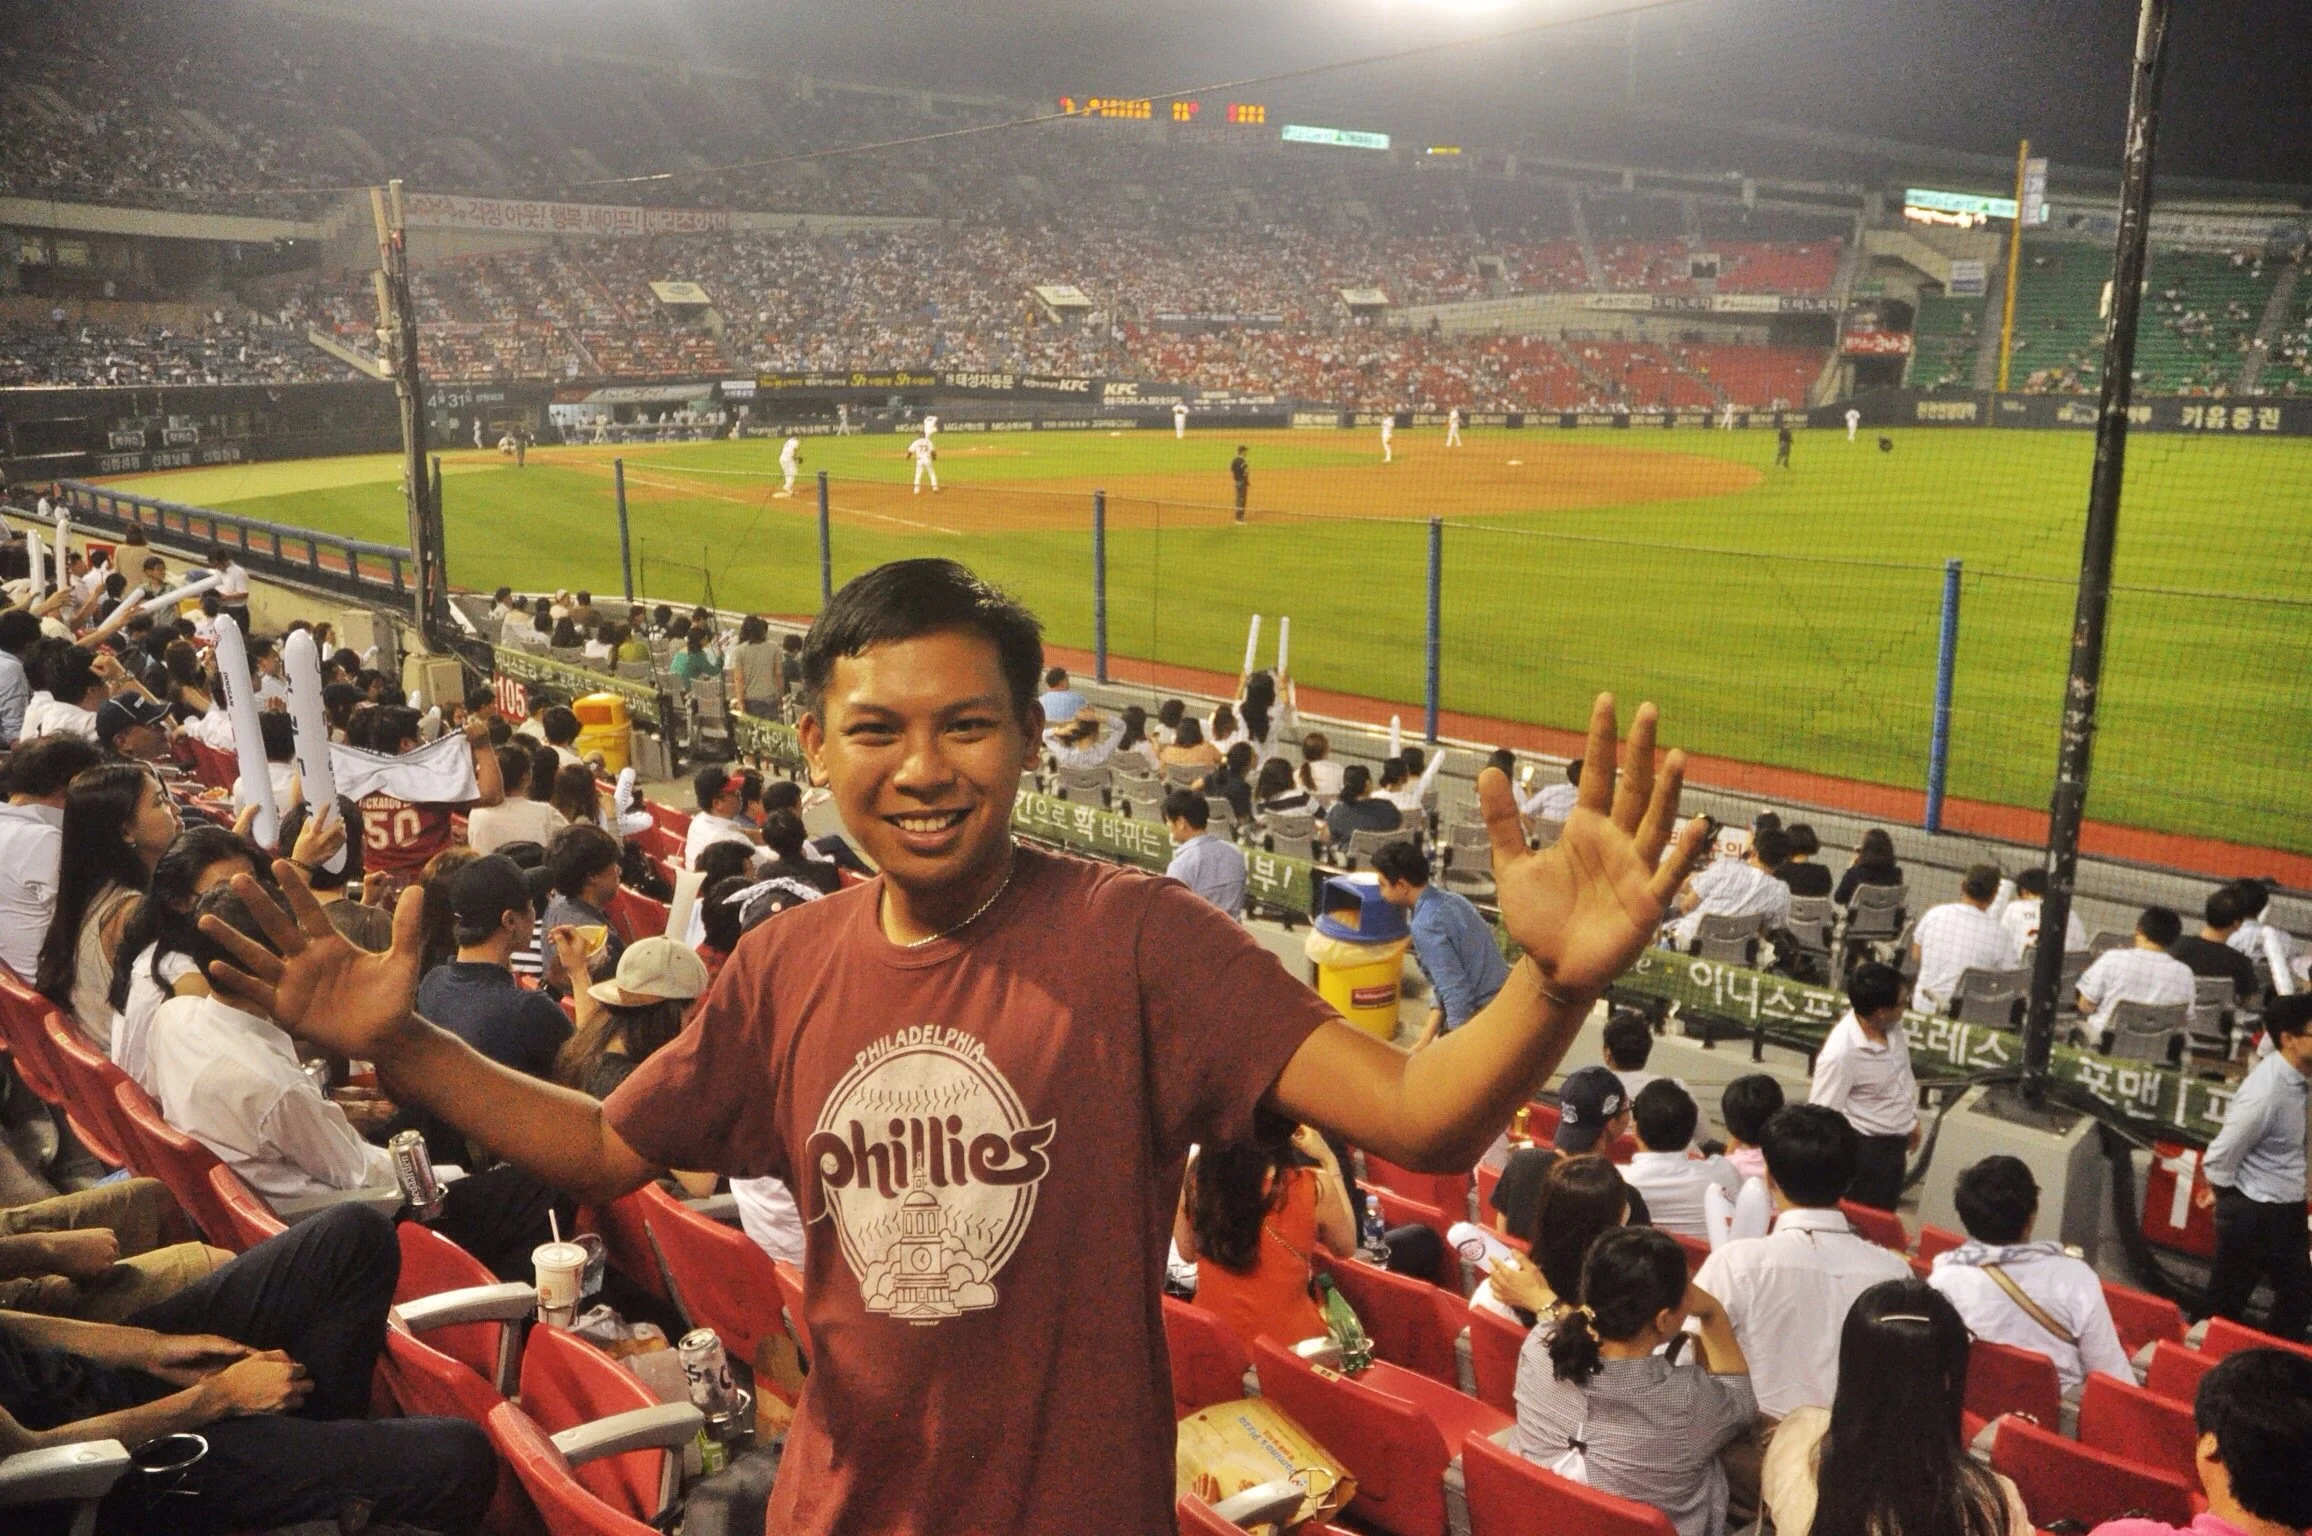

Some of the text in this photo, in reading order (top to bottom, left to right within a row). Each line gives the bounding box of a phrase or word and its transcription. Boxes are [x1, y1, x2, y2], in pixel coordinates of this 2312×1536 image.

[468, 201, 500, 227] 걱정
[505, 203, 546, 229] 아웃!
[550, 204, 582, 230] 행복
[586, 206, 640, 232] 세이프!
[956, 373, 1014, 389] 대성자동문
[1060, 379, 1090, 392] KFC
[1104, 383, 1139, 396] KFC
[2181, 405, 2281, 430] 키움증권
[495, 651, 537, 681] 이니스프리
[496, 675, 526, 718] 105
[362, 809, 421, 850] 50
[1014, 789, 1069, 830] 킨으로
[1073, 805, 1097, 843] 확
[1102, 817, 1161, 858] 바뀌는
[855, 1024, 986, 1071] PHILADELPHIA
[1690, 960, 1848, 1023] 이니스프
[1902, 1010, 2010, 1069] 포레스
[2075, 1056, 2162, 1121] 포맨
[401, 1154, 421, 1201] oegaarden
[806, 1114, 1056, 1225] phillies
